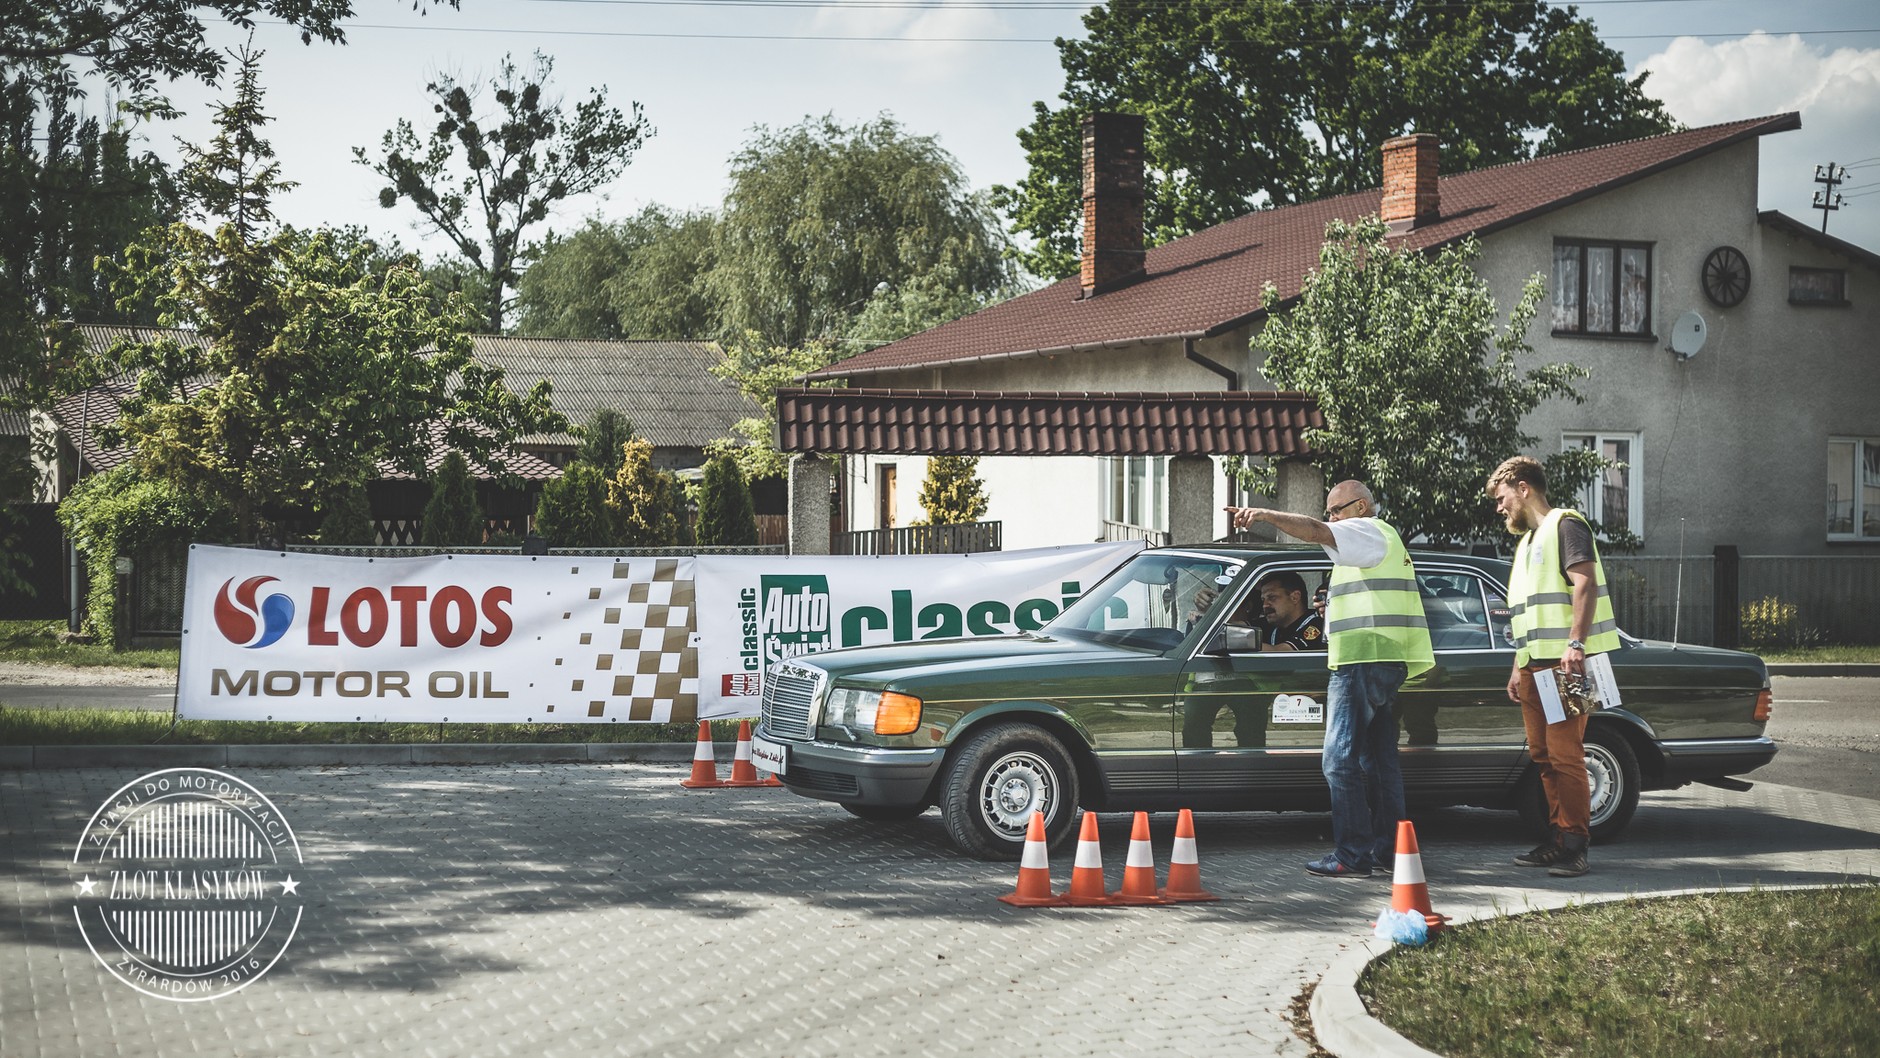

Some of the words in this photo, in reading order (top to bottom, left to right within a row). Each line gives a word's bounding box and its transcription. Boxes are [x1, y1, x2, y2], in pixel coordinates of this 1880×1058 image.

[308, 585, 513, 648] LOTOS
[738, 588, 759, 671] classic
[762, 586, 829, 633] Auto
[211, 668, 411, 698] MOTOR
[428, 671, 509, 699] OIL
